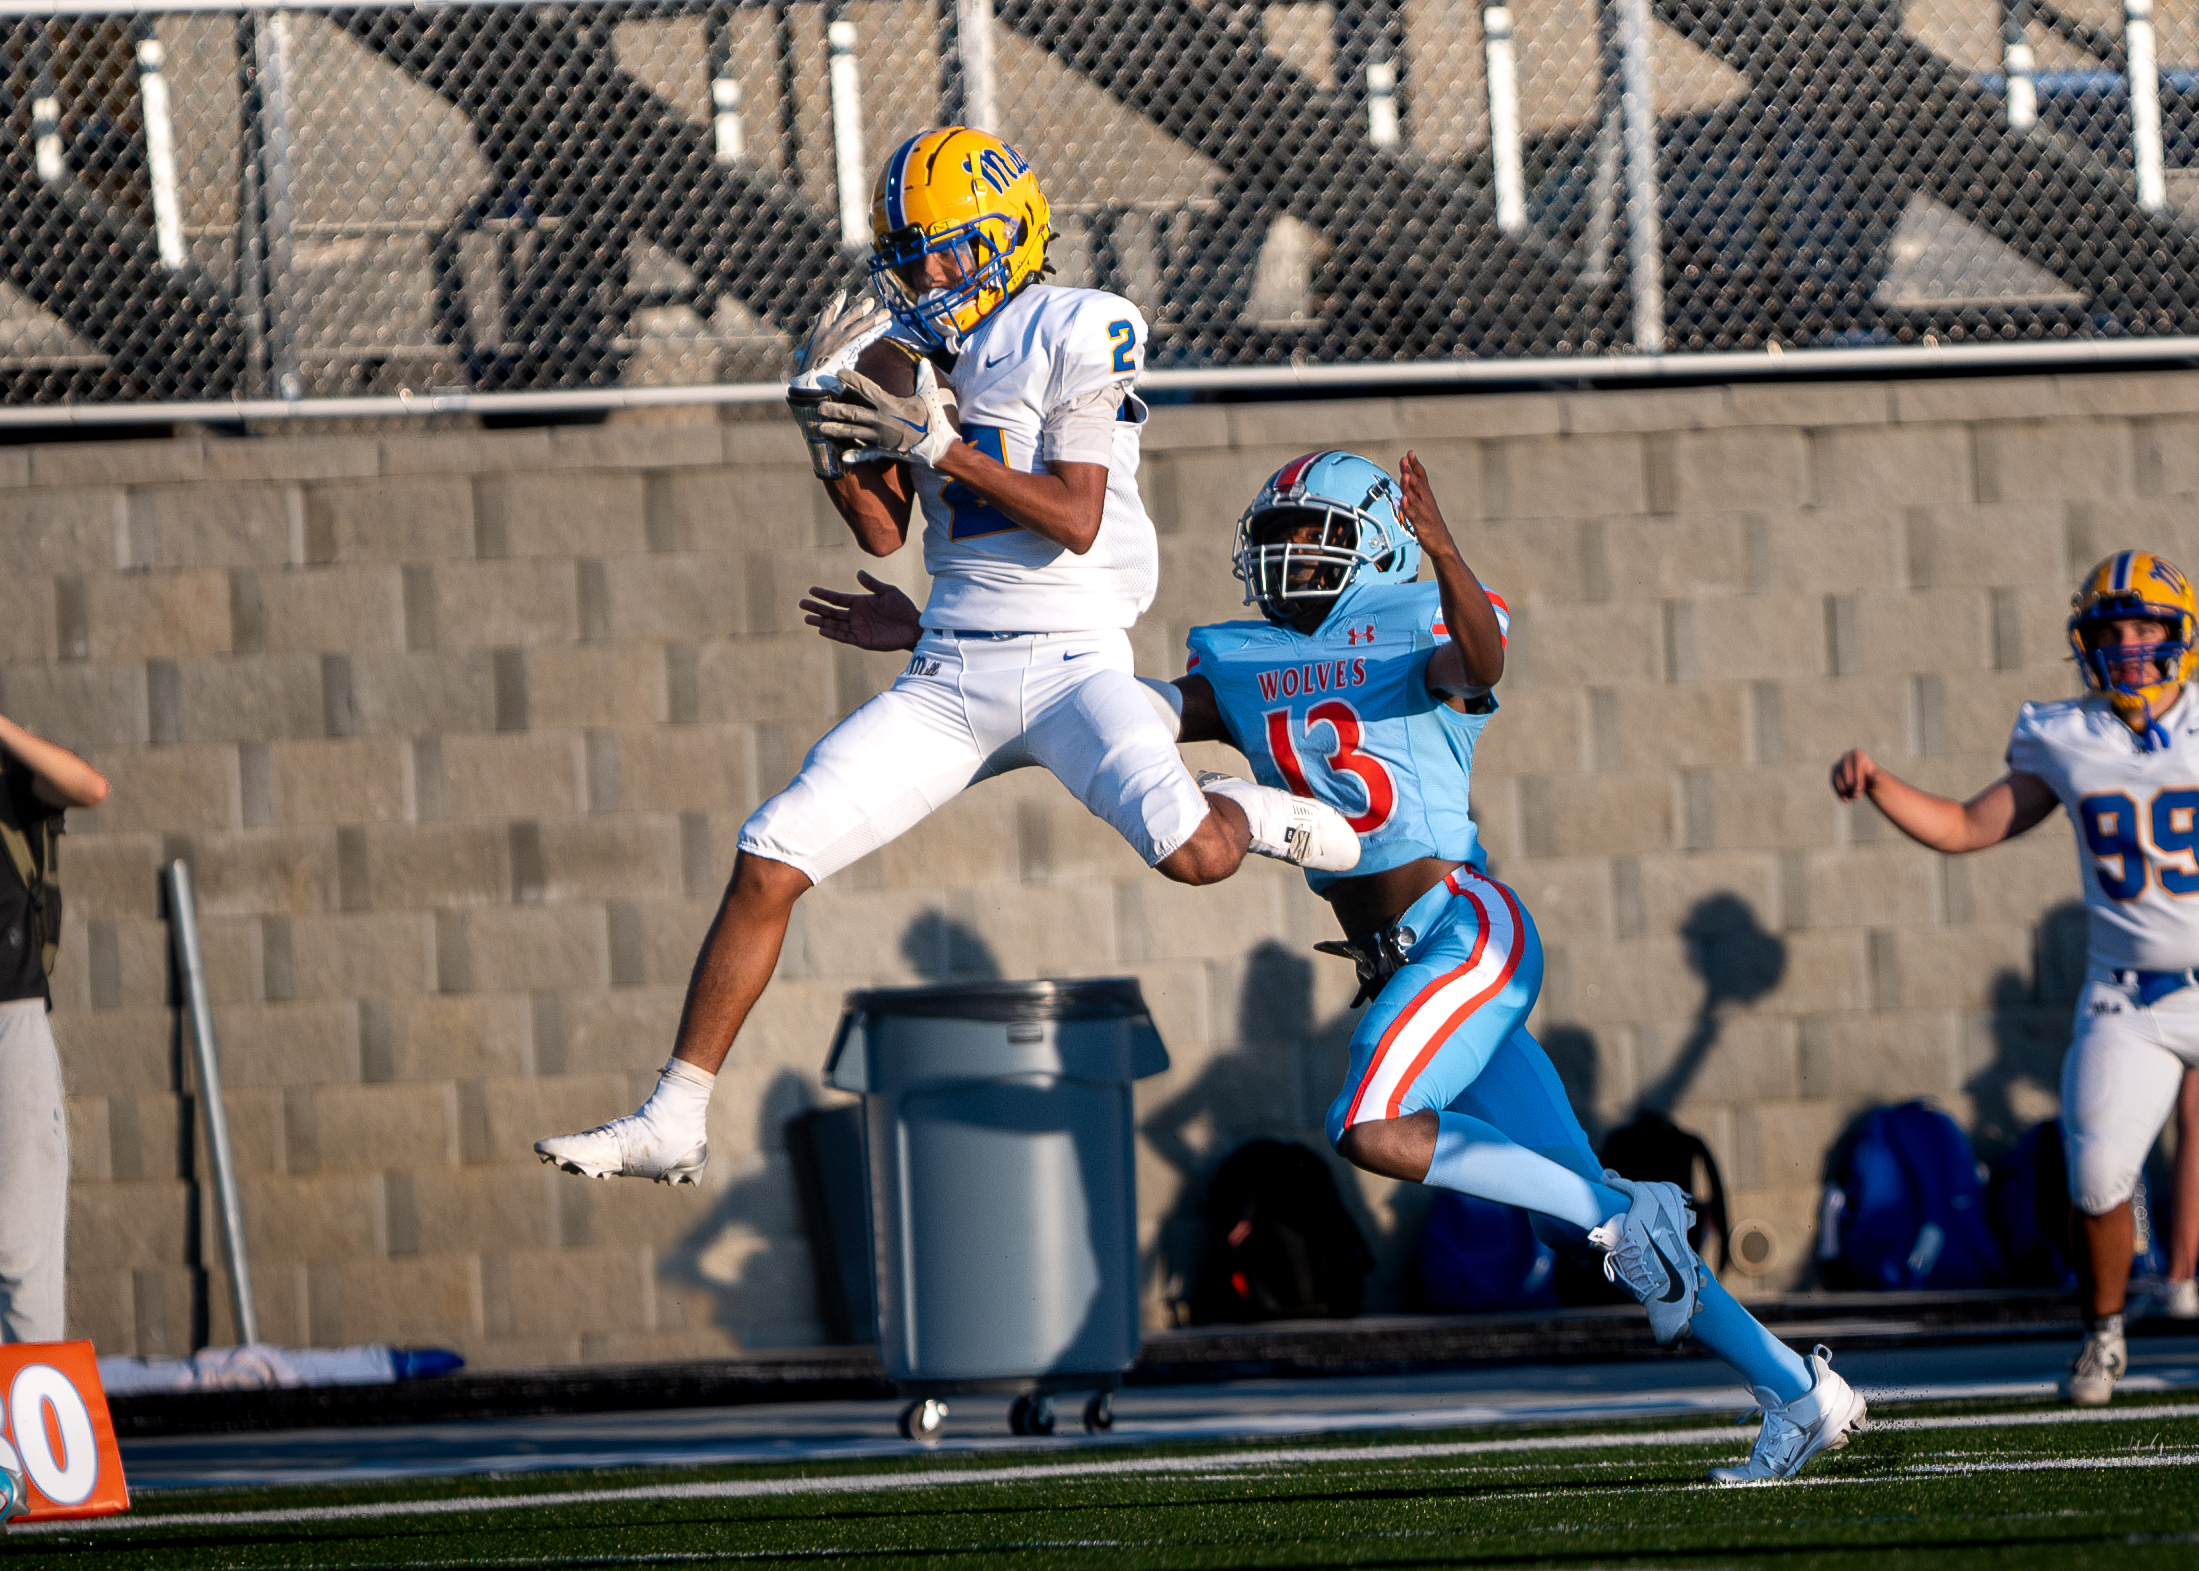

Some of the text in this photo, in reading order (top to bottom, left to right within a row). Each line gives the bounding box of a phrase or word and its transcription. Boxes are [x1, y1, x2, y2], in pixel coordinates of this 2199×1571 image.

[1105, 317, 1136, 374] 2
[1256, 655, 1368, 704] WOLVES
[1260, 696, 1400, 837] 13
[2078, 784, 2199, 904] 99
[0, 1362, 99, 1506] 0
